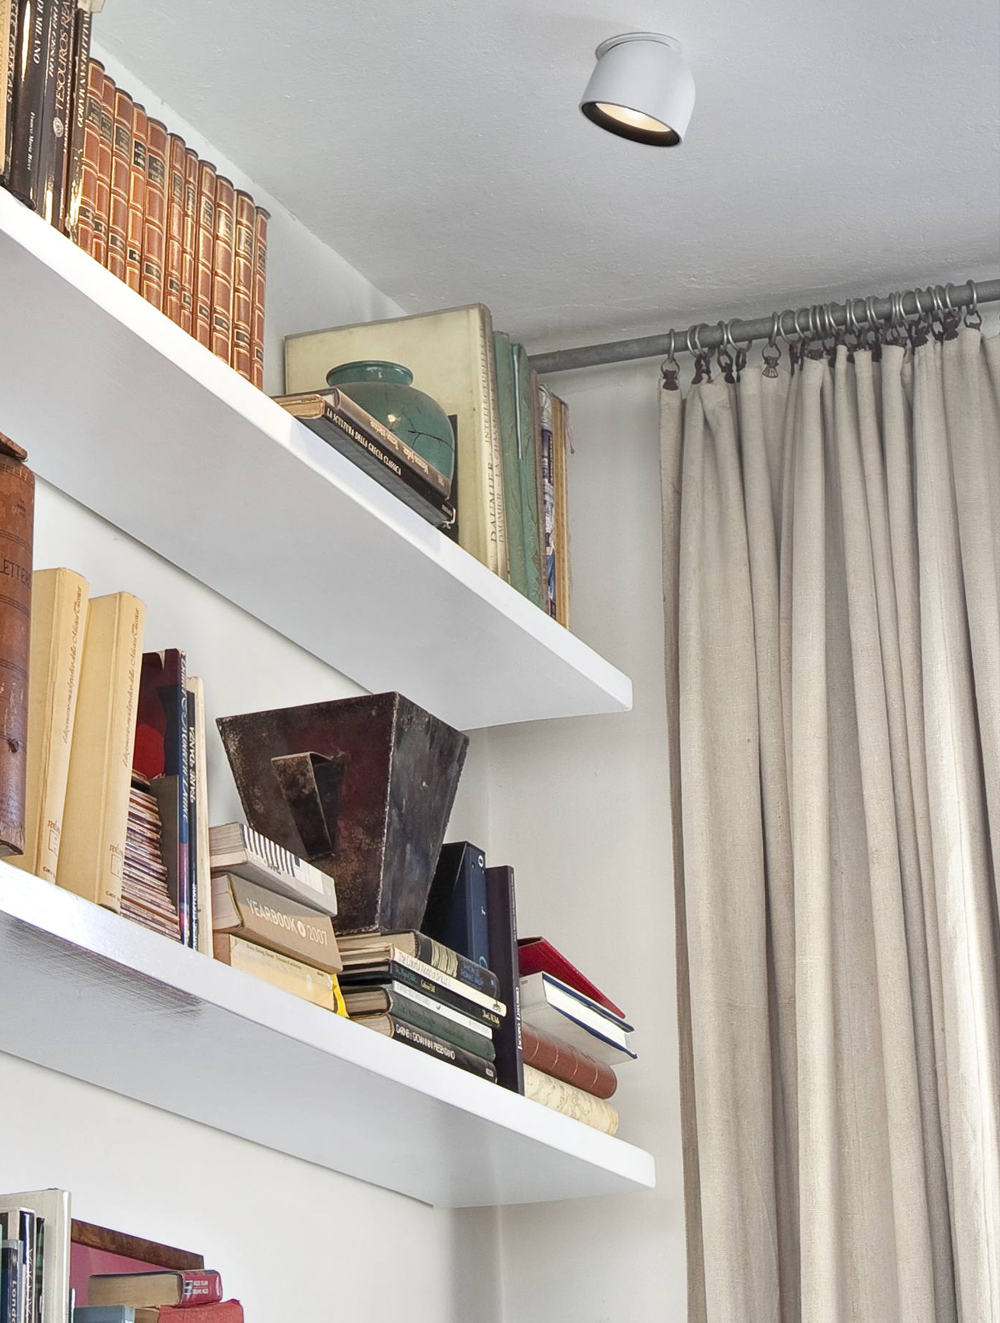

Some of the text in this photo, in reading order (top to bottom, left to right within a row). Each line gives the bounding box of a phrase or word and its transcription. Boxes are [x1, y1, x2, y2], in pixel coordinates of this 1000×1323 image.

[33, 12, 44, 64] MILANO
[55, 31, 70, 110] TESOUROS
[79, 63, 88, 85] SAN
[77, 86, 88, 128] MARCO
[327, 407, 402, 476] LA SCULTURA DELLA GRECIA CLASSICA
[487, 462, 497, 543] DAUMIER
[496, 493, 504, 543] DAUMIER
[188, 726, 196, 767] DANZA
[246, 896, 328, 946] YEARBOOK 2007
